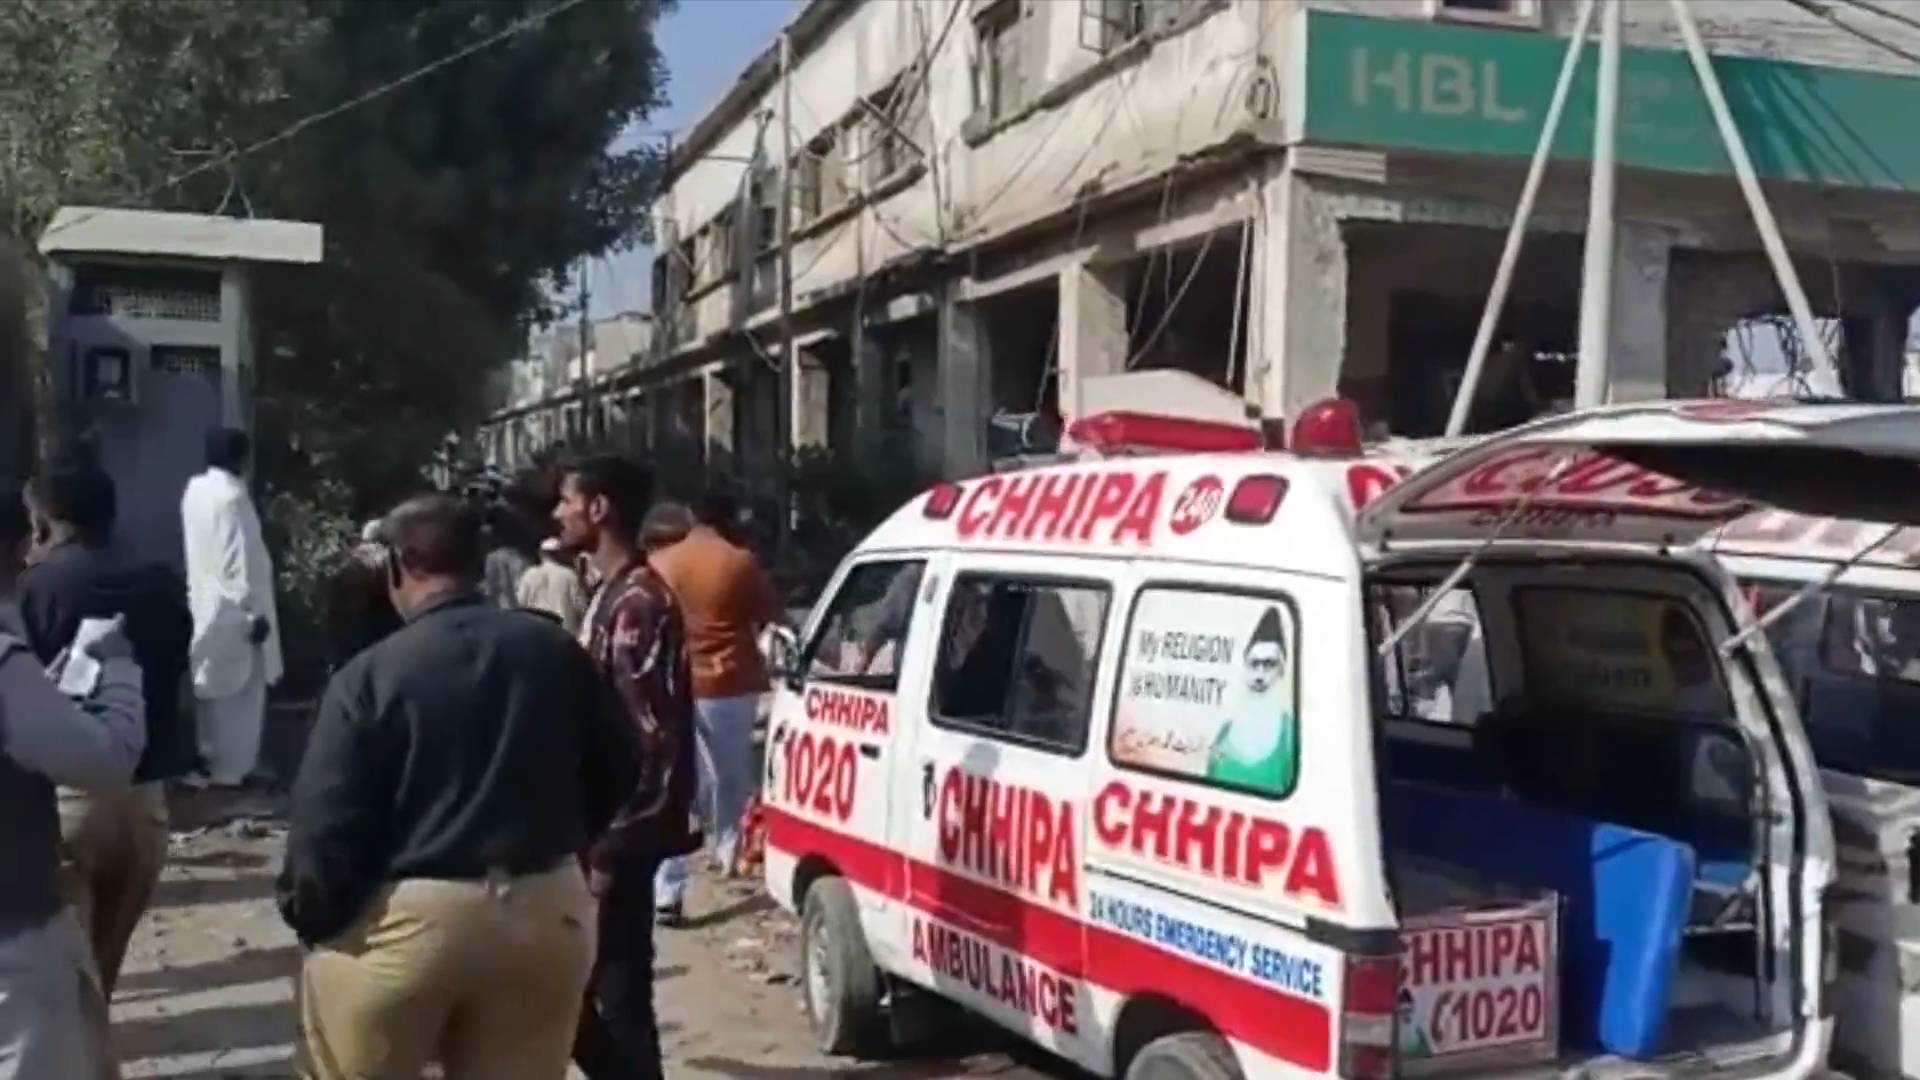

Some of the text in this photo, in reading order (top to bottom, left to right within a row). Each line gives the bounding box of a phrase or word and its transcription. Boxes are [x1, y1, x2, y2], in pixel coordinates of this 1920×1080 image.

[1350, 47, 1526, 122] HBL
[957, 472, 1168, 546] CHHIPA
[1161, 631, 1234, 663] RELIGION
[806, 688, 888, 734] CHHIPA
[1143, 672, 1227, 705] HUMANITY
[784, 728, 858, 823] 1020
[938, 764, 1080, 909] CHHIPA
[1093, 780, 1344, 911] CHHIPA
[912, 919, 1076, 1035] AMBULANCE
[1107, 898, 1152, 938] HOURS
[1156, 912, 1248, 972] EMERGENCY
[1252, 944, 1323, 999] SERVICE
[1451, 983, 1542, 1040] 1020
